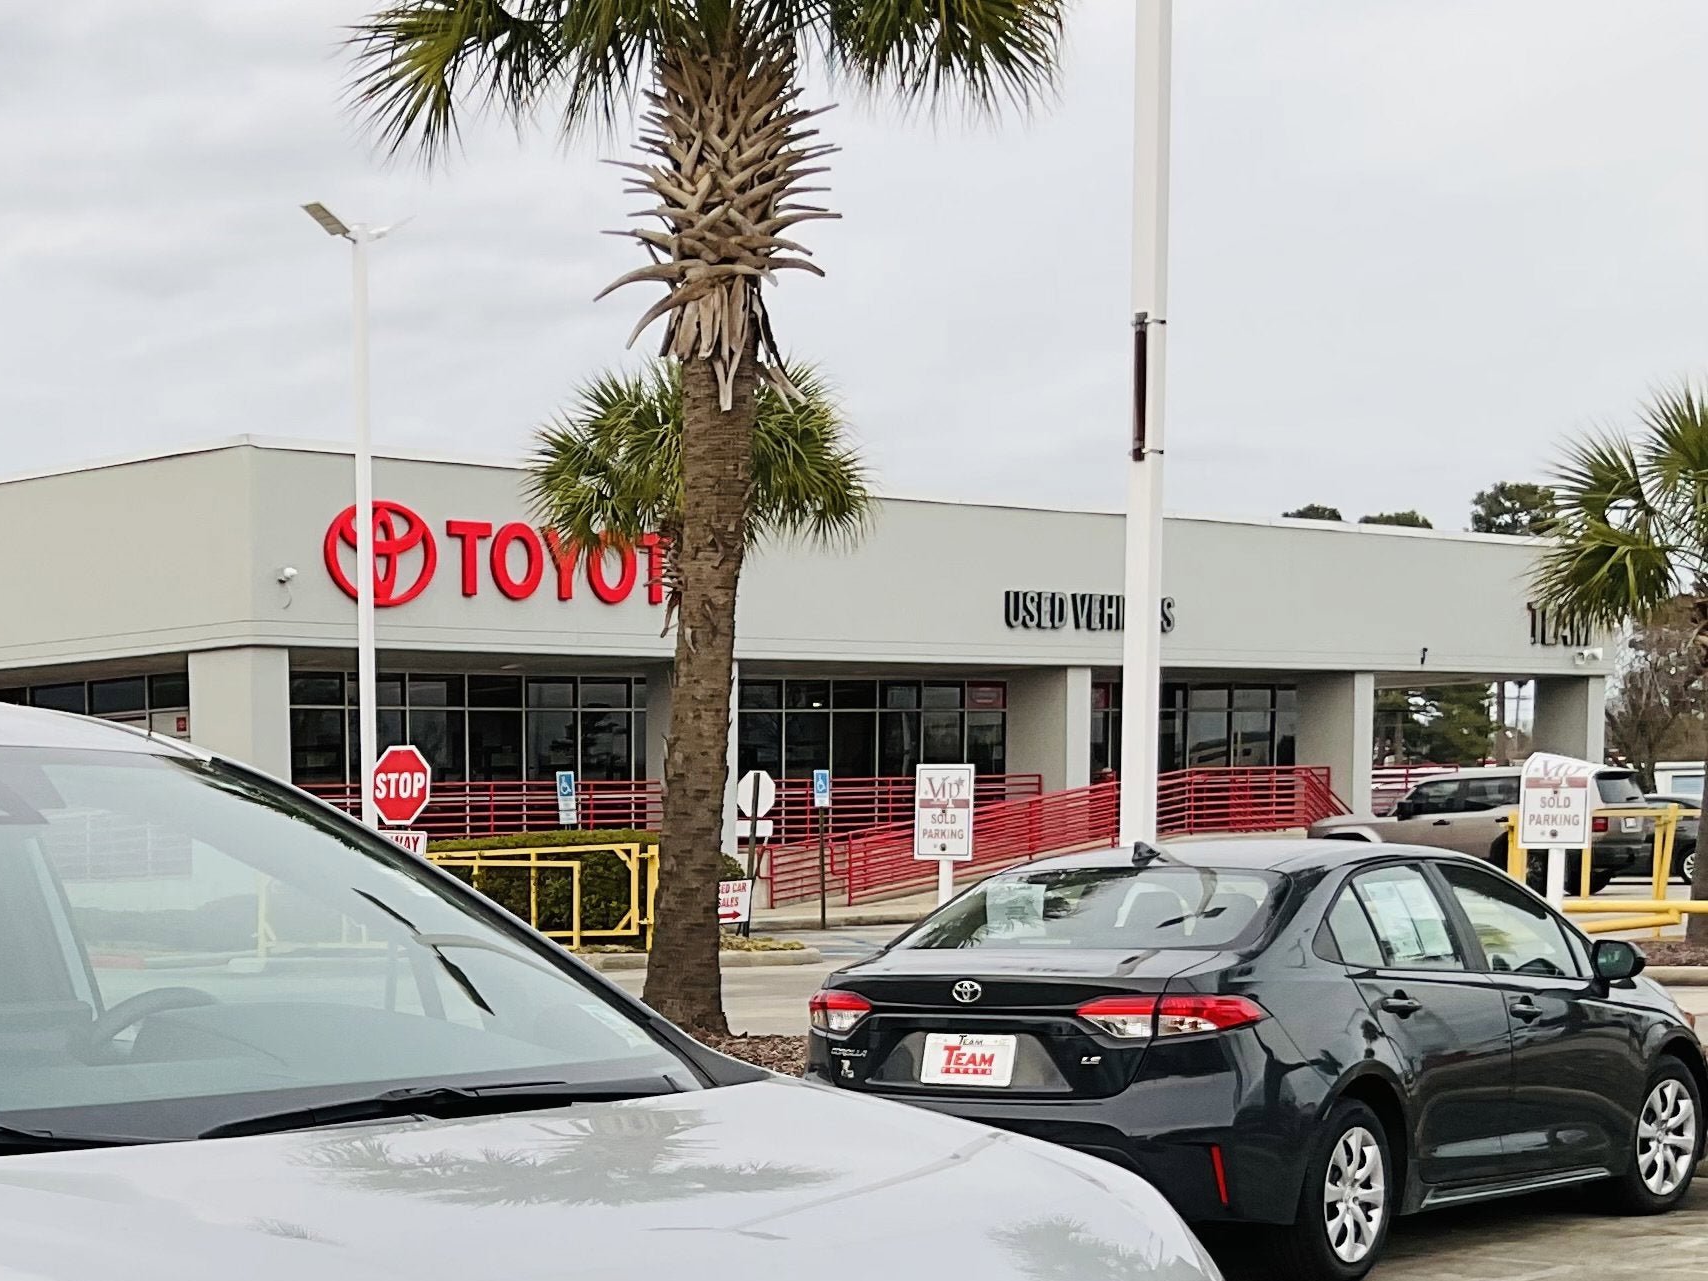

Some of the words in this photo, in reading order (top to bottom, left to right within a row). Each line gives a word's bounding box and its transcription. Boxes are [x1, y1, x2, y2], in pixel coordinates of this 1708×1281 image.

[445, 519, 674, 606] TOYOT
[1005, 590, 1068, 629] USED
[1070, 592, 1176, 634] VEHIS
[375, 771, 426, 799] STOP
[1539, 796, 1571, 809] SOLD
[930, 813, 957, 825] SOLD
[1528, 813, 1580, 826] PARKING
[922, 828, 964, 840] PARKING
[720, 883, 730, 895] ED
[732, 882, 747, 893] CAR
[720, 896, 740, 908] ALES
[943, 1045, 995, 1067] TEAM
